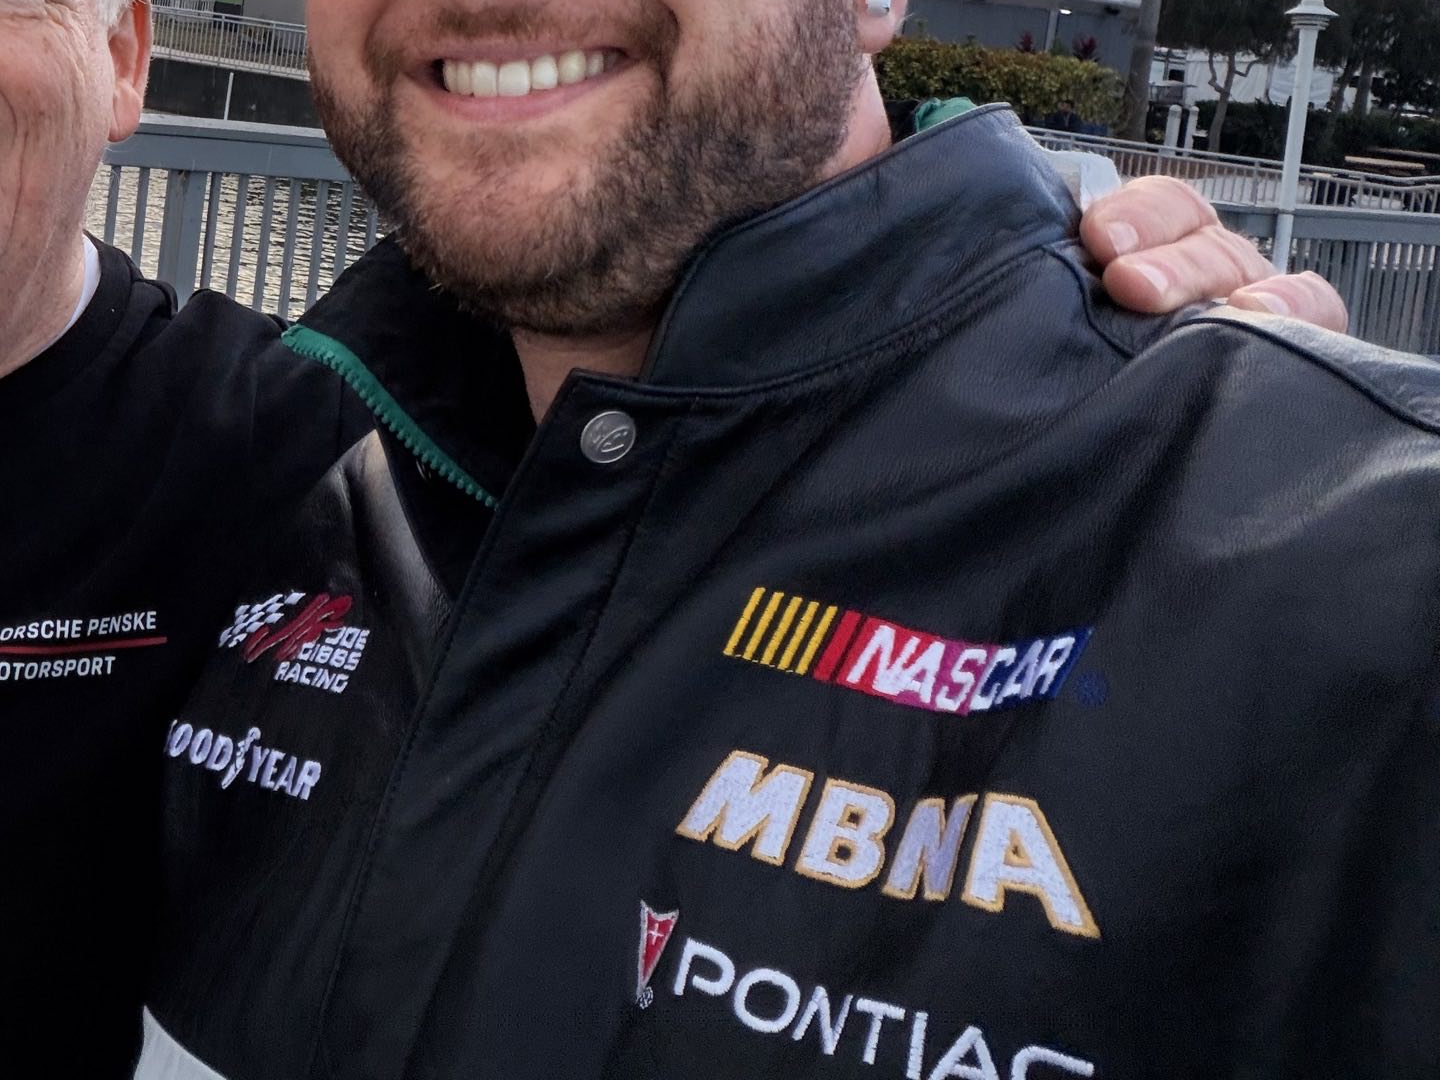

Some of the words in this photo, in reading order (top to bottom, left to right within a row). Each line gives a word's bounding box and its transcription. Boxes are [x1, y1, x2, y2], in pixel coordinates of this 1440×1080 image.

[87, 611, 157, 637] PENSKE
[324, 626, 370, 651] JOE
[297, 641, 362, 671] GIBBS
[848, 624, 1076, 712] NASCAR
[274, 661, 349, 694] RACING
[675, 750, 1101, 940] MBNA
